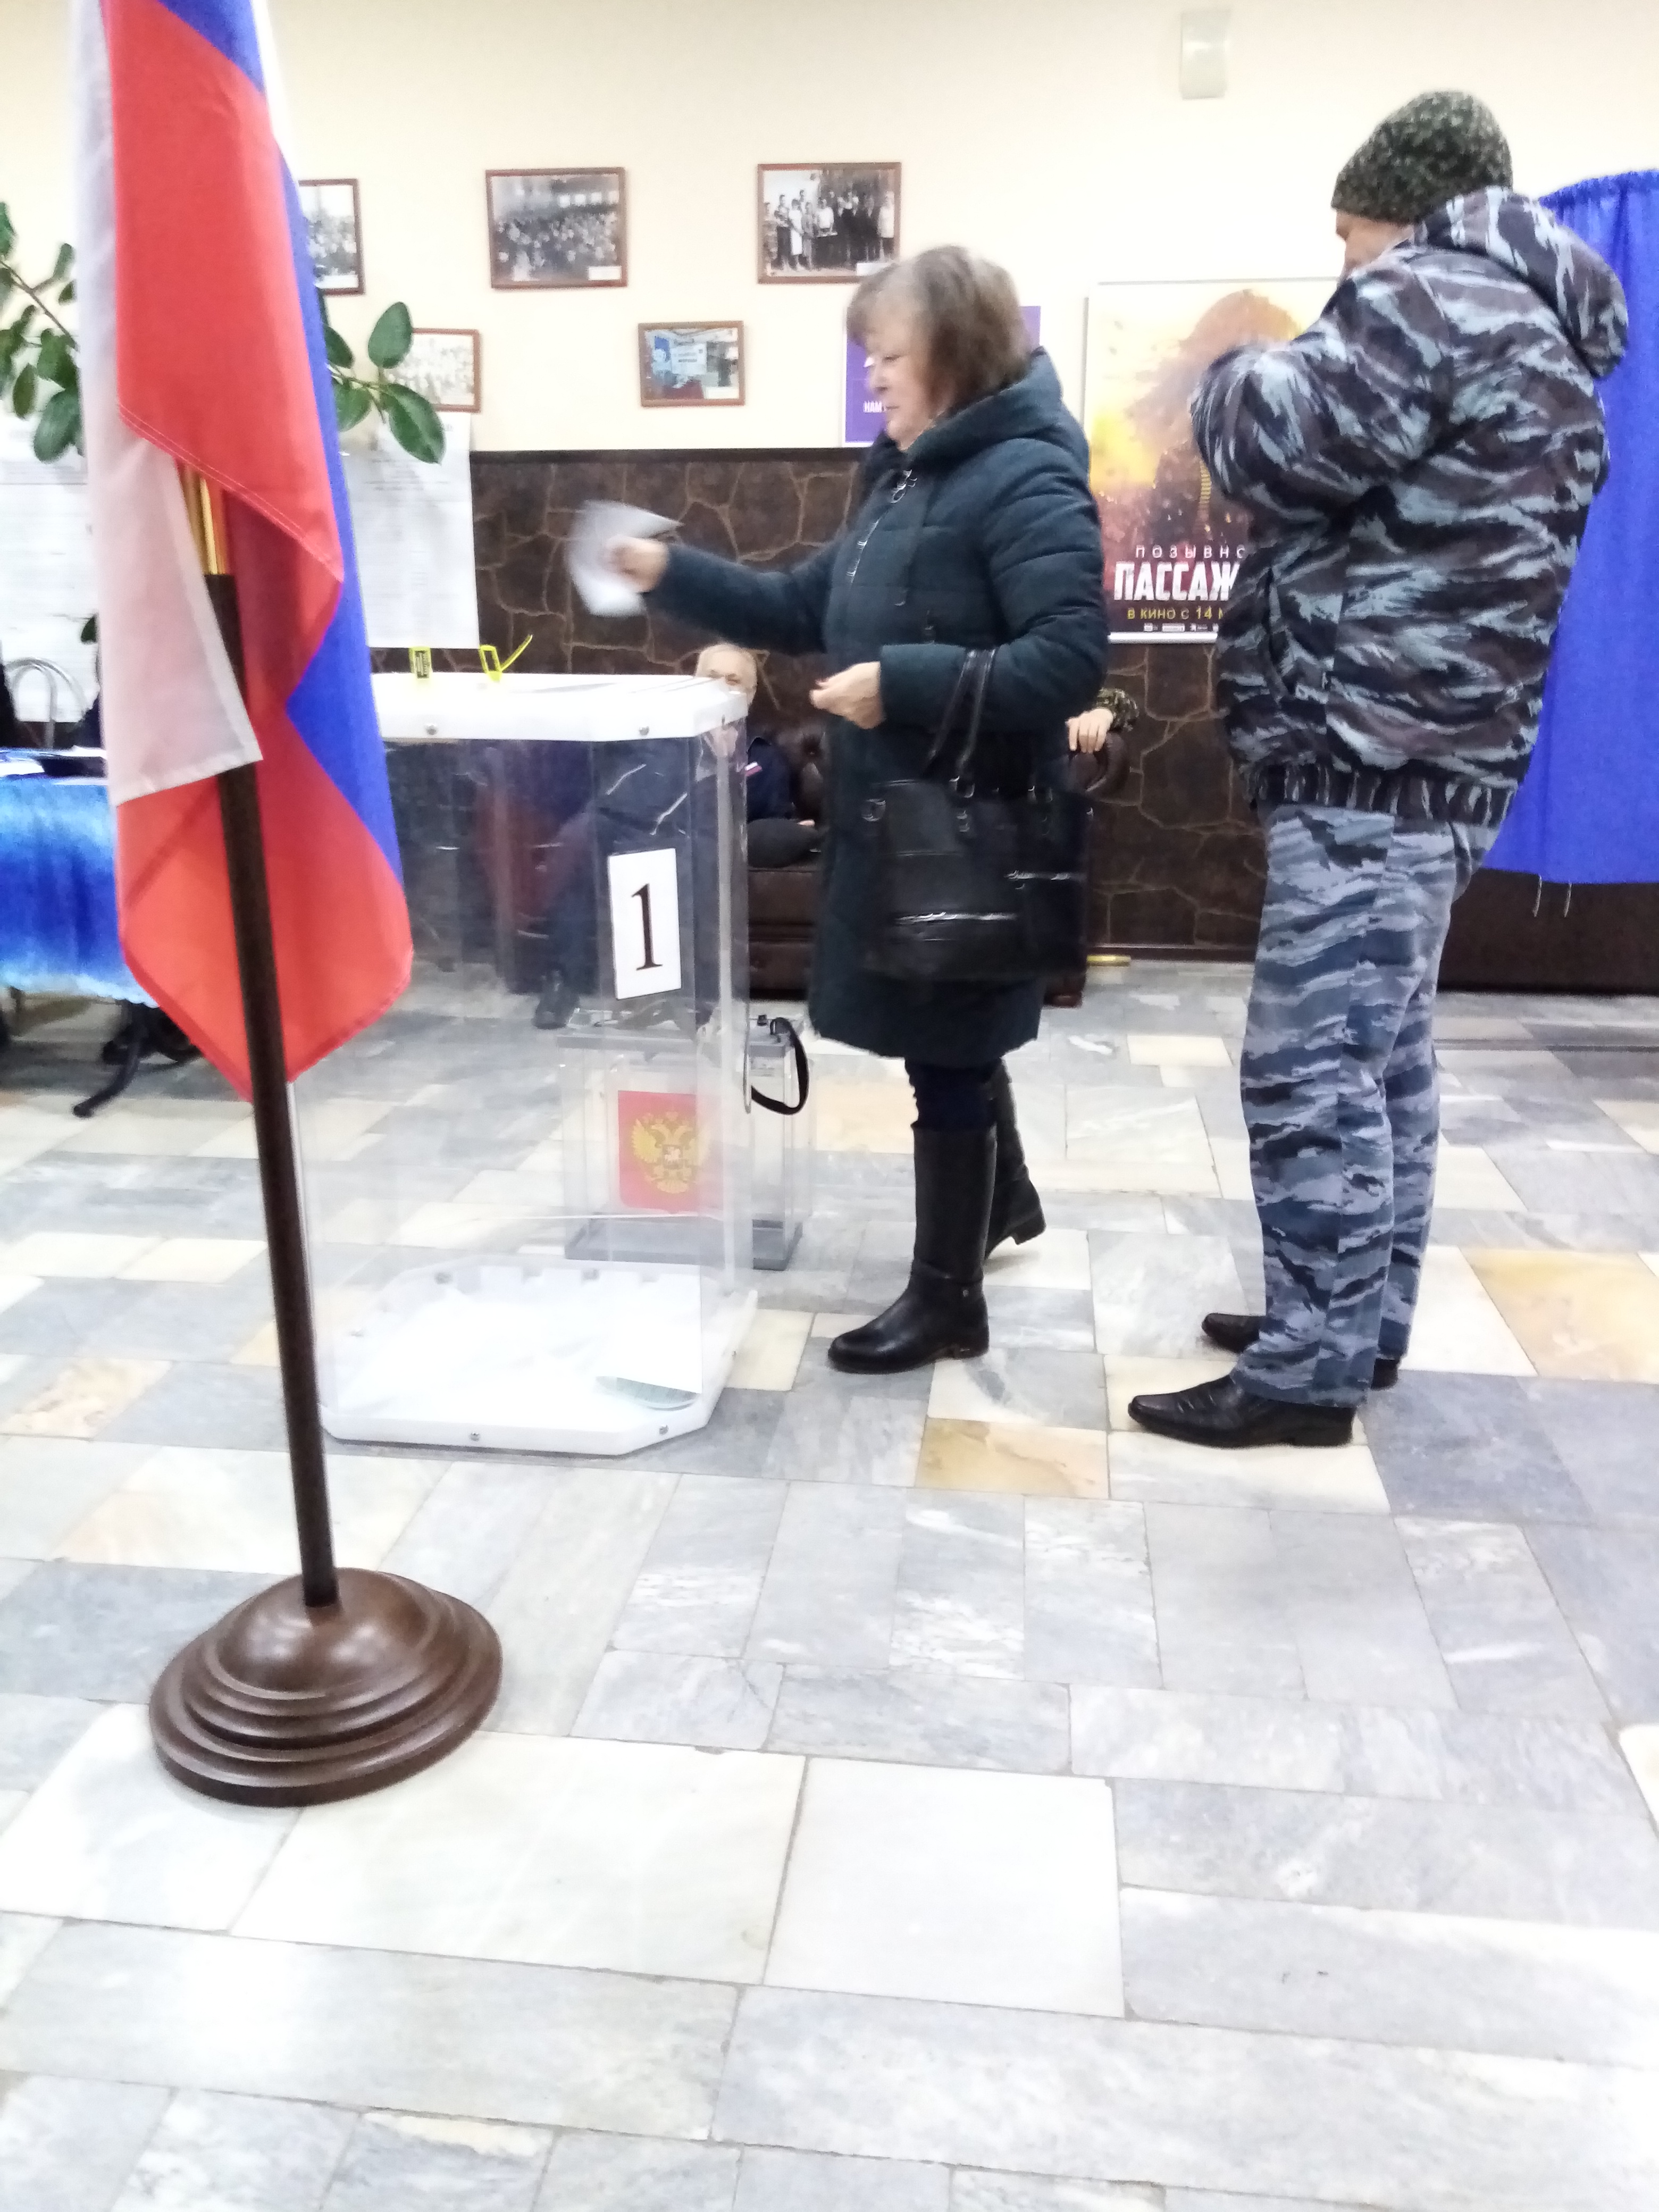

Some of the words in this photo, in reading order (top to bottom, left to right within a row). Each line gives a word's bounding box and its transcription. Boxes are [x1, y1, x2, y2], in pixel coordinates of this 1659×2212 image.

[1113, 561, 1240, 601] ПАССАЖ
[1127, 607, 1135, 619] В
[1140, 607, 1176, 620] КИНО
[1180, 608, 1189, 620] С
[1196, 606, 1212, 619] 14
[631, 883, 663, 971] 1
